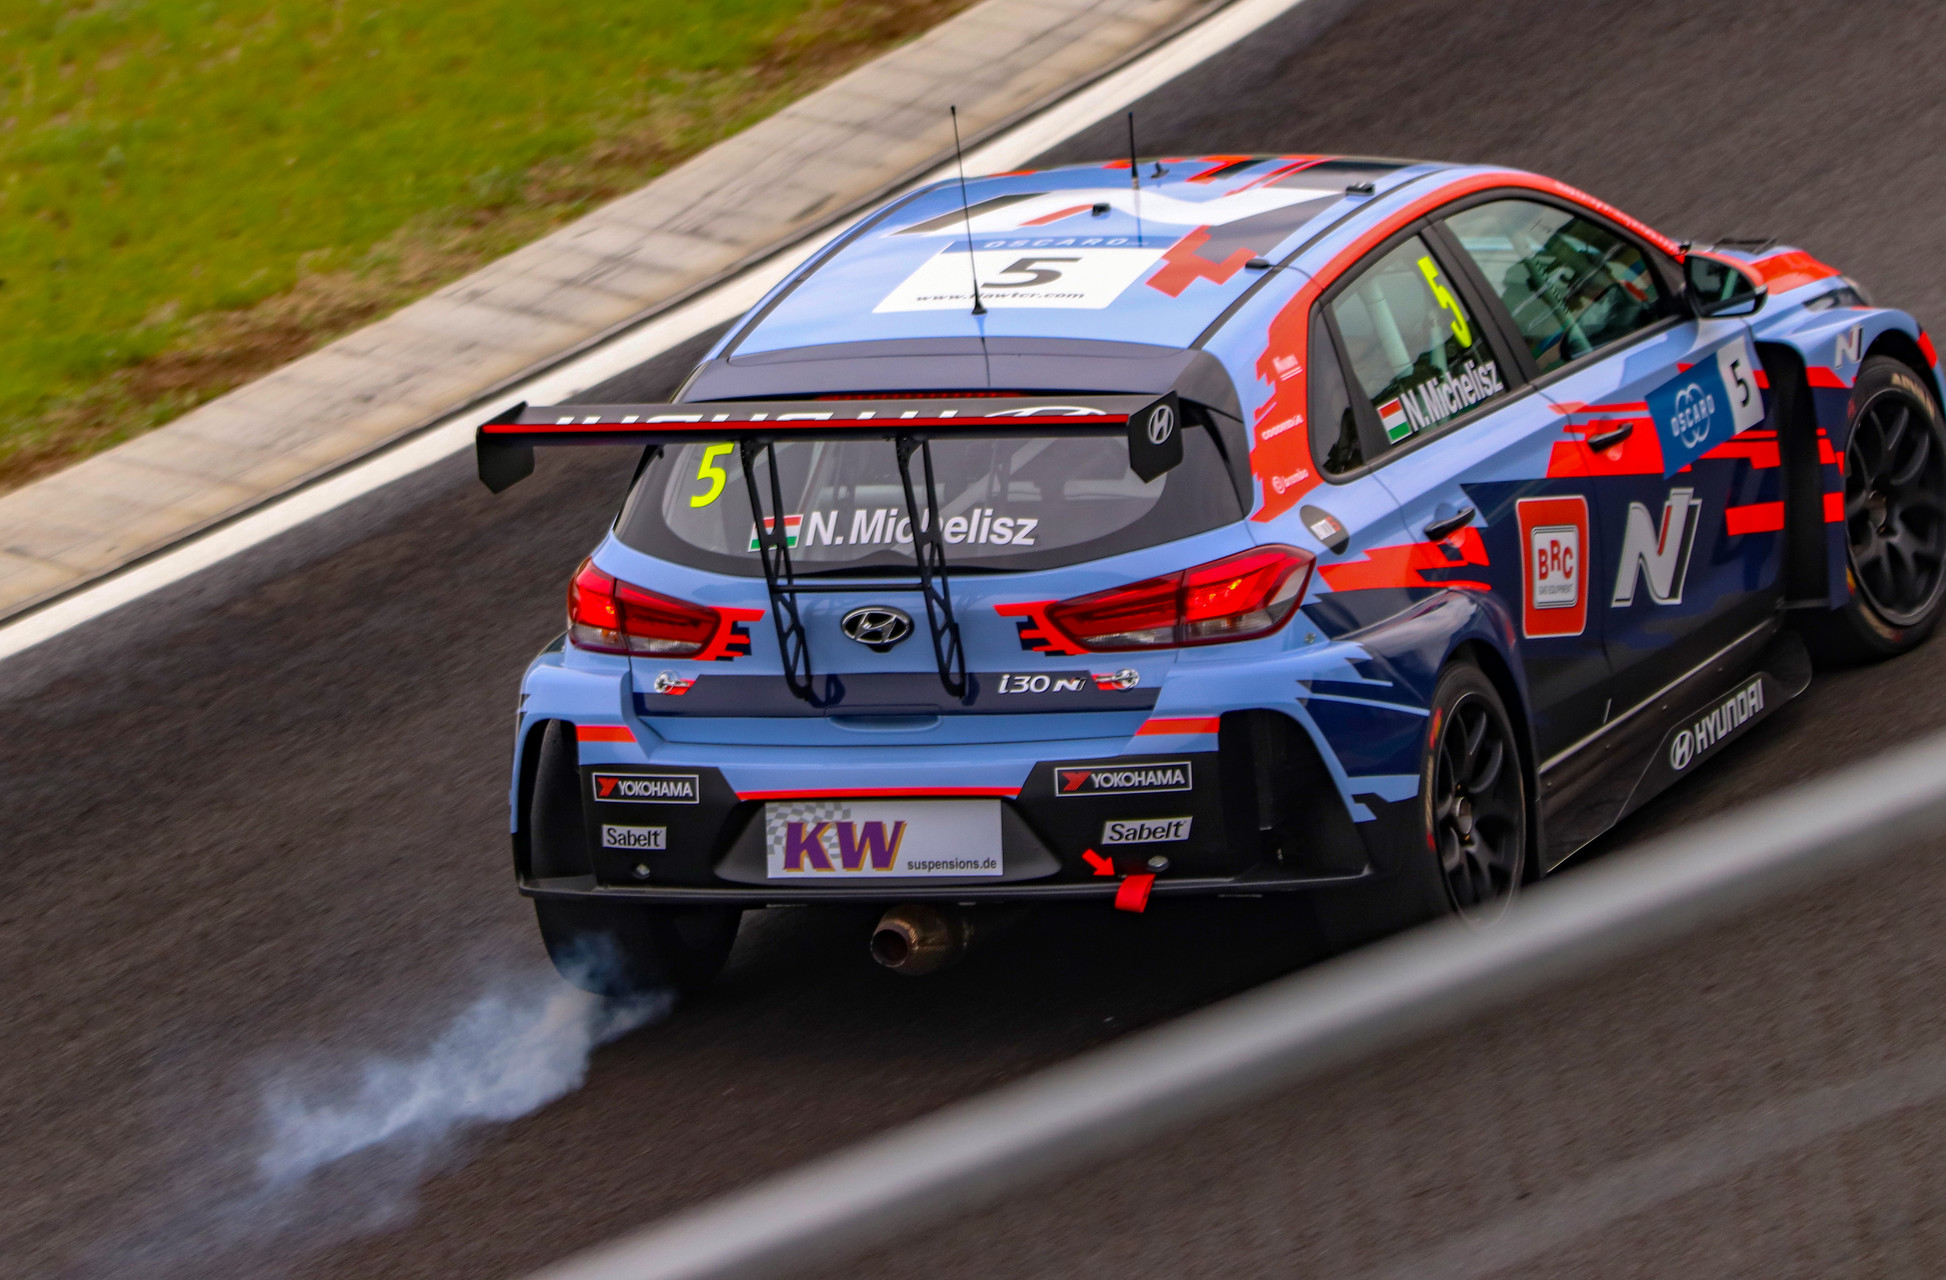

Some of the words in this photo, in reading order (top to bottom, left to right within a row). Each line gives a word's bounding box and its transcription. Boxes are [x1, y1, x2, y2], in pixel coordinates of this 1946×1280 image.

[981, 257, 1083, 289] 5
[1417, 256, 1472, 348] 5
[1401, 359, 1504, 432] N.Michelisz
[1729, 358, 1750, 408] 5
[1670, 394, 1715, 437] OSCARO
[690, 442, 735, 508] 5
[1538, 539, 1573, 580] BRC
[998, 674, 1050, 694] i30
[1694, 678, 1764, 754] HYUNDAI
[618, 780, 693, 797] YOKOHAMA
[1091, 768, 1185, 788] YOKOHAMA
[607, 827, 660, 847] Sabelt
[783, 820, 908, 872] KW
[1109, 821, 1183, 841] Sabelt
[907, 856, 997, 872] suspensions.de
